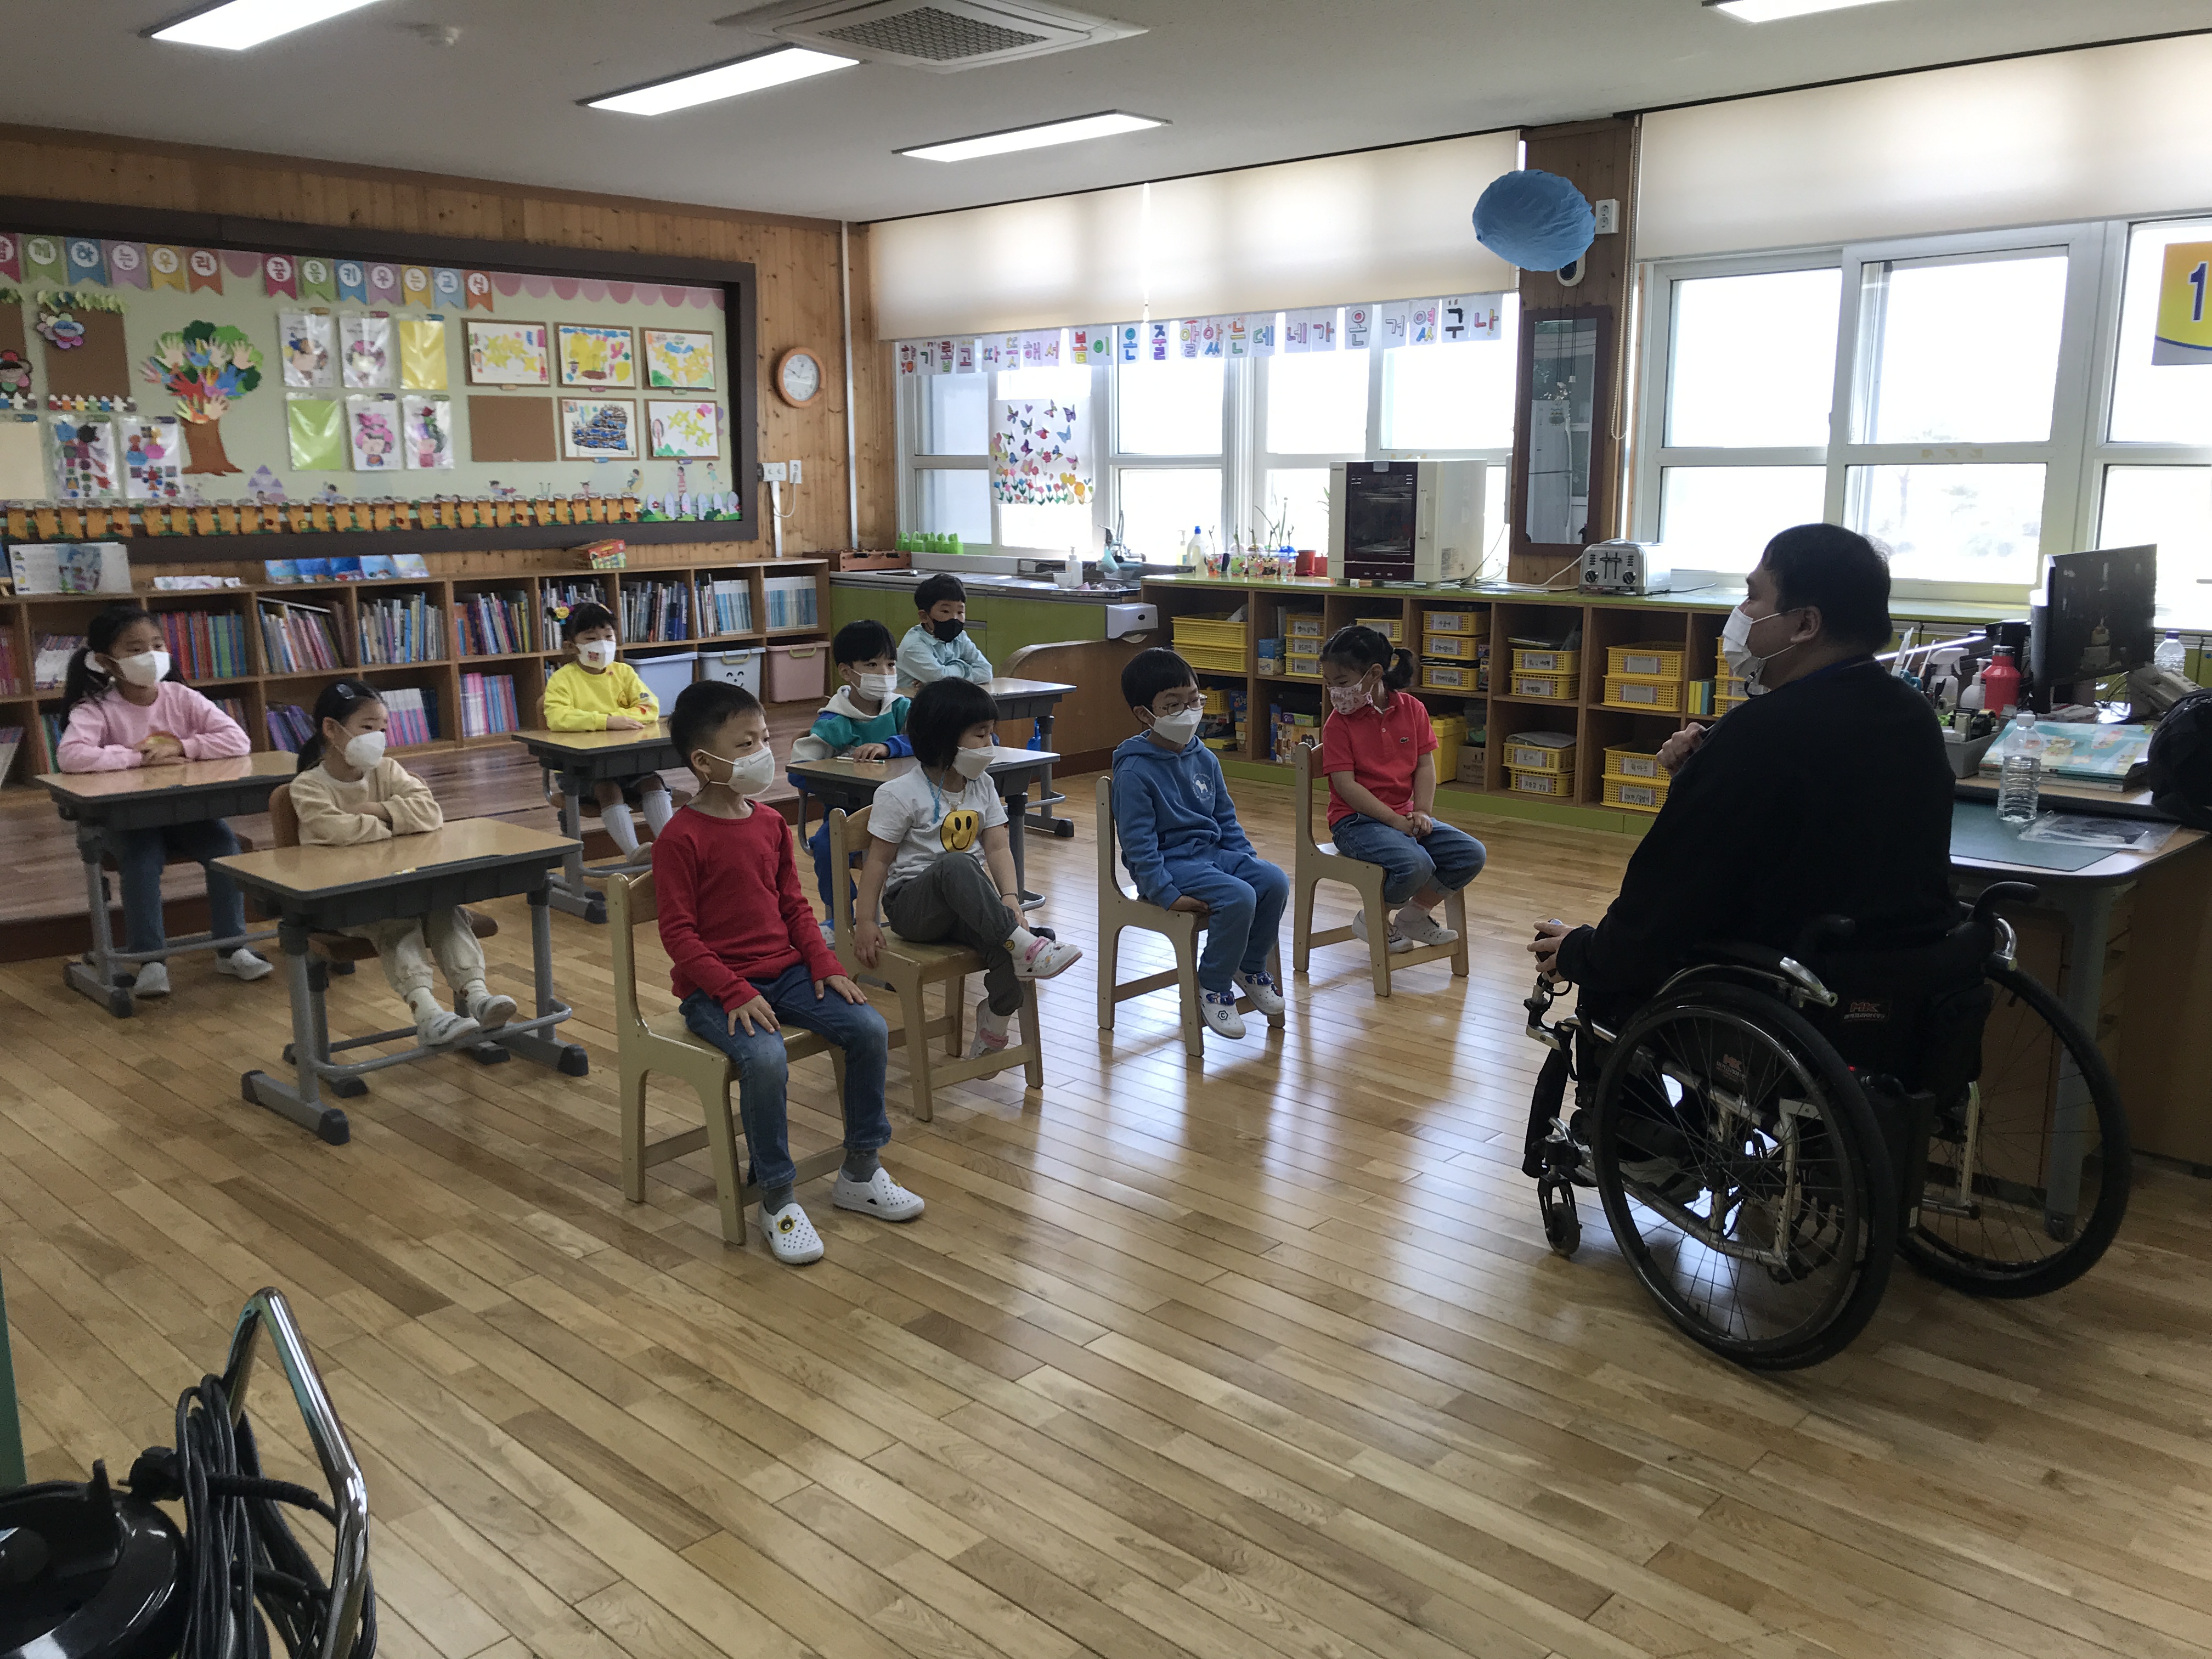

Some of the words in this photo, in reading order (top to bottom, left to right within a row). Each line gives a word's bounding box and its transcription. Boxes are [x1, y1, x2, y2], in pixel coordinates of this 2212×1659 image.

[159, 251, 211, 270] 우리
[273, 260, 322, 284] 꿈을
[345, 267, 422, 290] 키우는
[2189, 262, 2208, 321] 1
[984, 336, 1059, 368] 따뜻해서
[1072, 331, 1110, 364] 봄이
[1122, 327, 1138, 360] 온
[1152, 324, 1166, 360] 줄
[1180, 321, 1274, 358] 알았는데
[1286, 321, 1334, 343] 네가
[1348, 309, 1367, 346] 온
[1386, 307, 1499, 342] 거였구나
